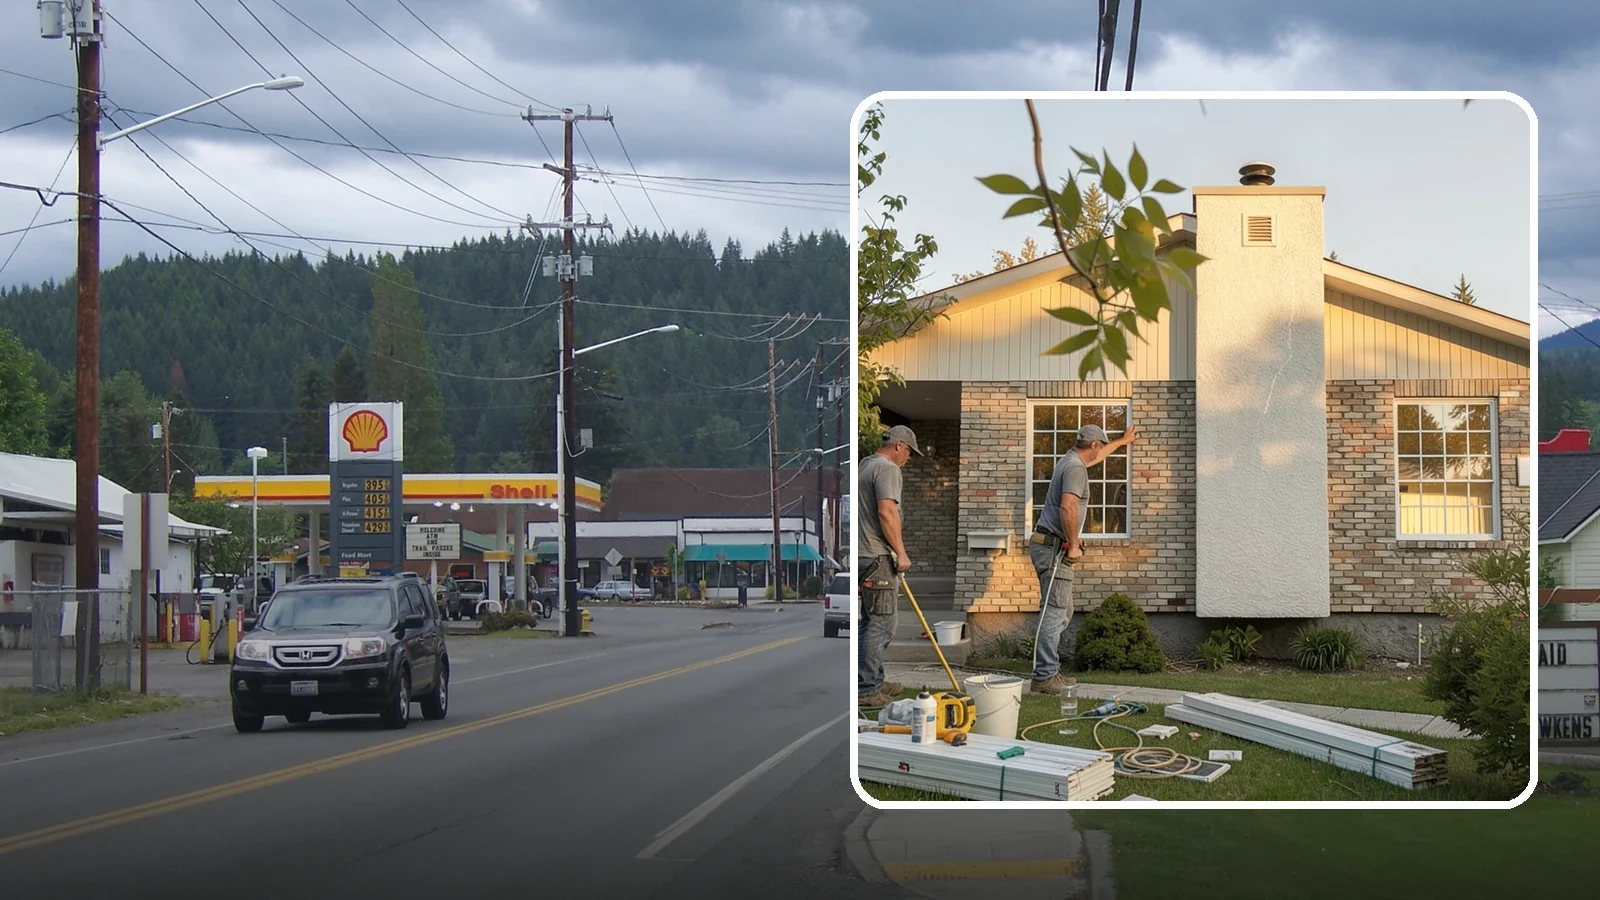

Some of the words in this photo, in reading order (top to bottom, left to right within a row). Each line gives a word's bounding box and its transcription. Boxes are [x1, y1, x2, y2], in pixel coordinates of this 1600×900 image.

[365, 480, 383, 490] 395
[490, 484, 547, 499] Shell
[365, 494, 383, 504] 405
[365, 508, 383, 518] 415
[365, 522, 383, 532] 429
